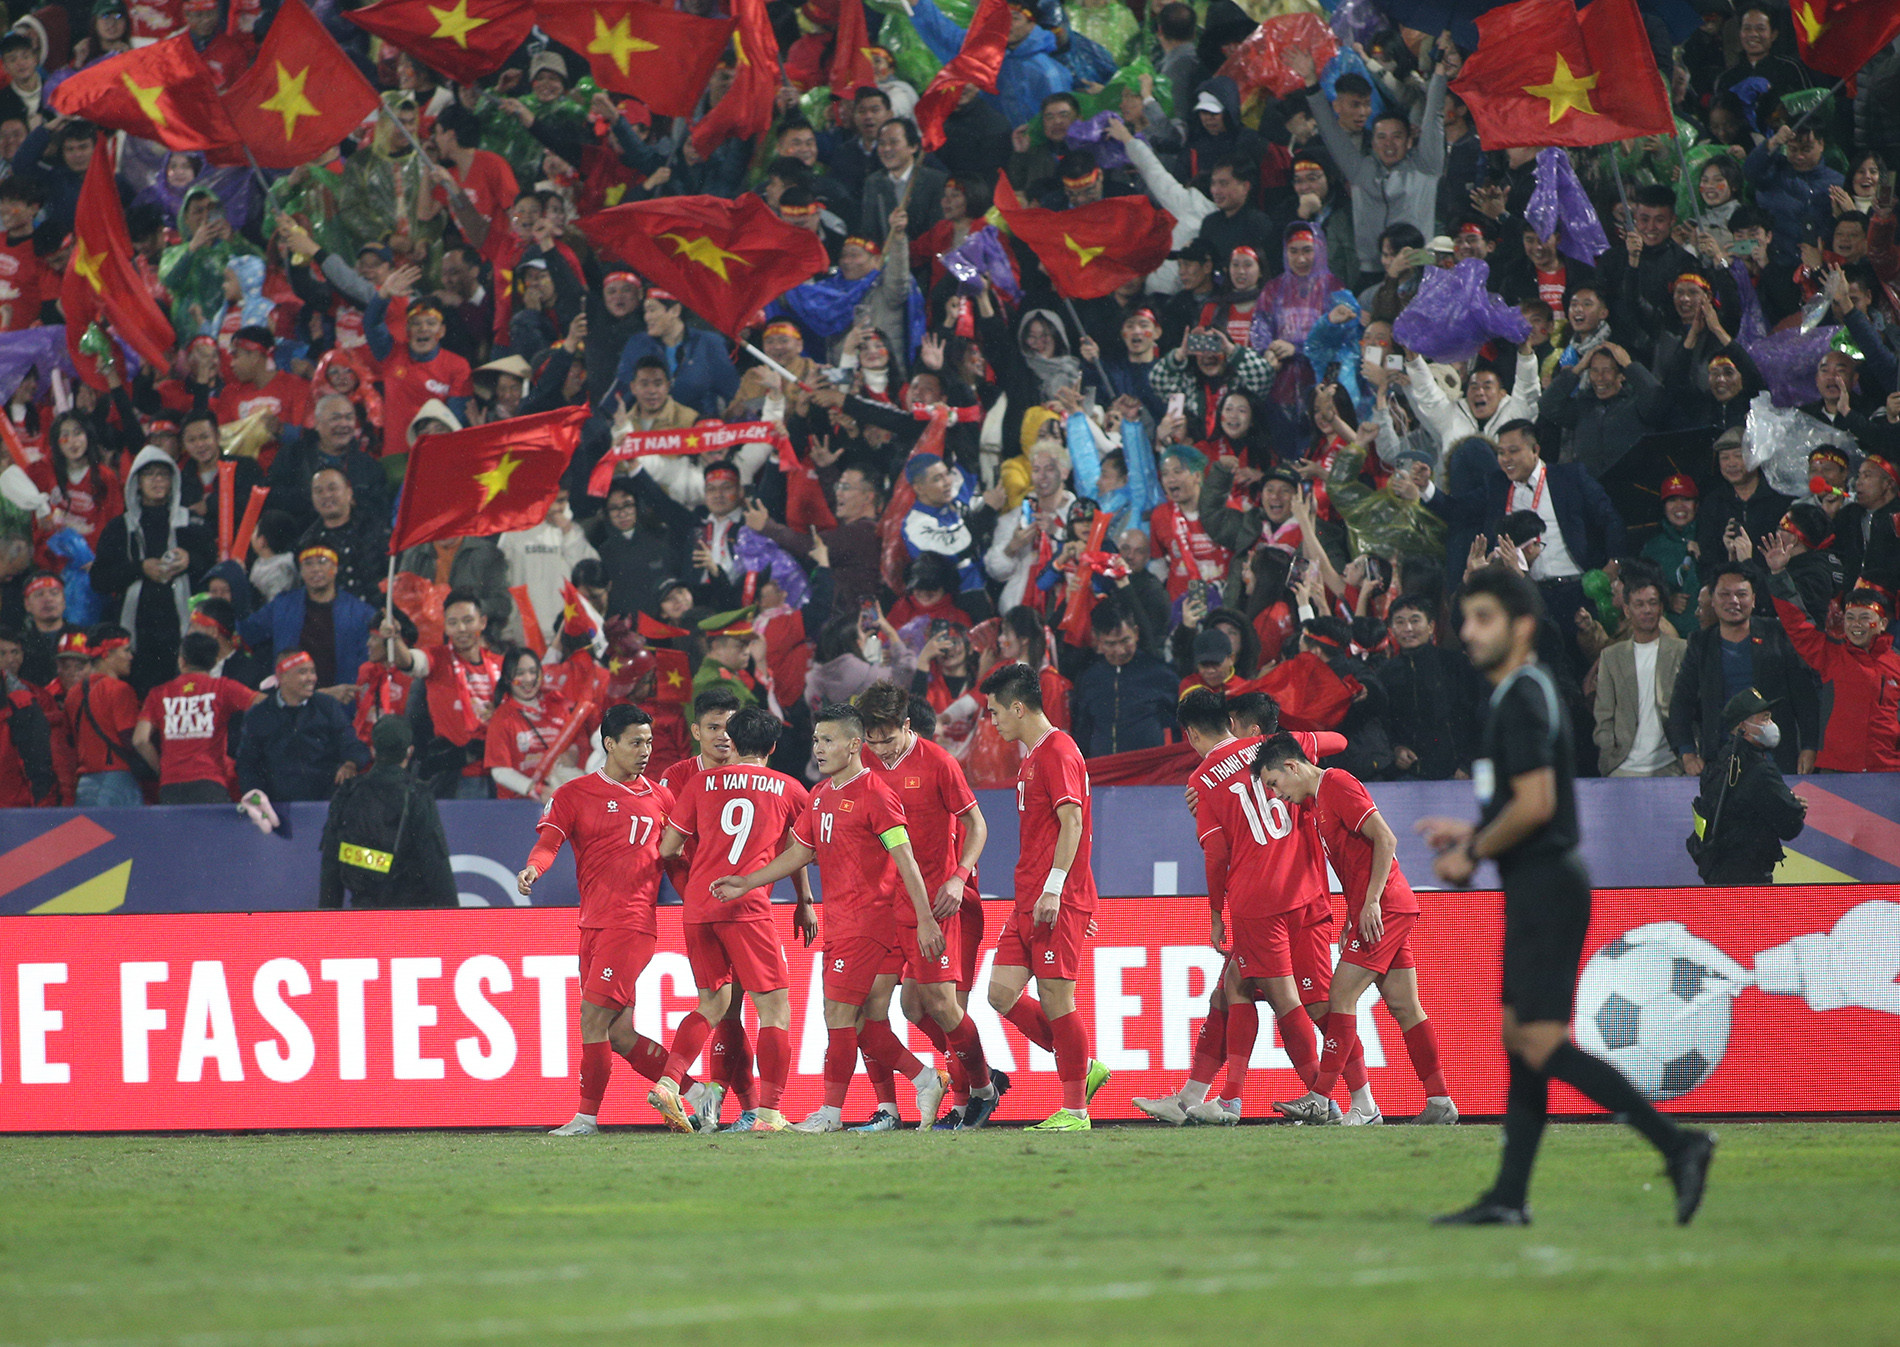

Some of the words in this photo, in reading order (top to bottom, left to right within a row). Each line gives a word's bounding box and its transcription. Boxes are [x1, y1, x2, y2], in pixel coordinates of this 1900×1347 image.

[645, 435, 681, 450] NAM
[162, 692, 216, 716] VIET
[164, 711, 215, 734] NAM
[1199, 773, 1218, 790] N.
[1208, 753, 1245, 783] THANH
[705, 775, 718, 792] N.
[722, 773, 749, 791] VAN
[751, 774, 786, 797] TOAN
[1228, 774, 1293, 846] 16
[628, 815, 654, 846] 17
[720, 797, 755, 866] 9
[820, 811, 834, 844] 19
[0, 962, 71, 1084] E
[120, 955, 580, 1084] FASTEST
[634, 943, 1388, 1077] GAKEP
